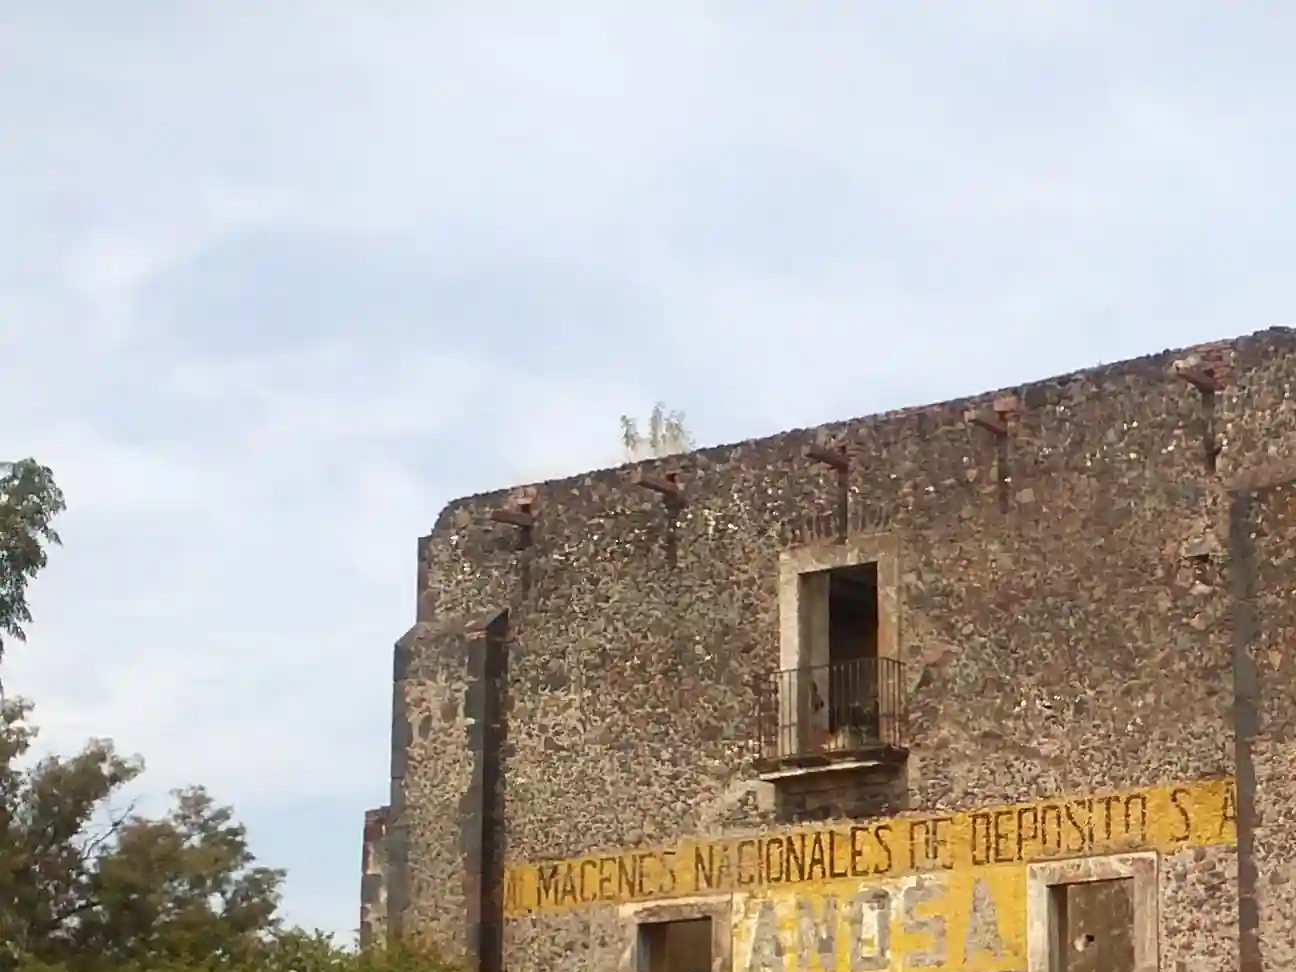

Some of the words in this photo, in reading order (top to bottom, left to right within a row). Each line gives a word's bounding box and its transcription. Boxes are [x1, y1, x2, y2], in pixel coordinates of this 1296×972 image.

[694, 824, 893, 892] NACIONALES
[910, 817, 954, 869] DE
[968, 793, 1147, 866] DEPOSITO
